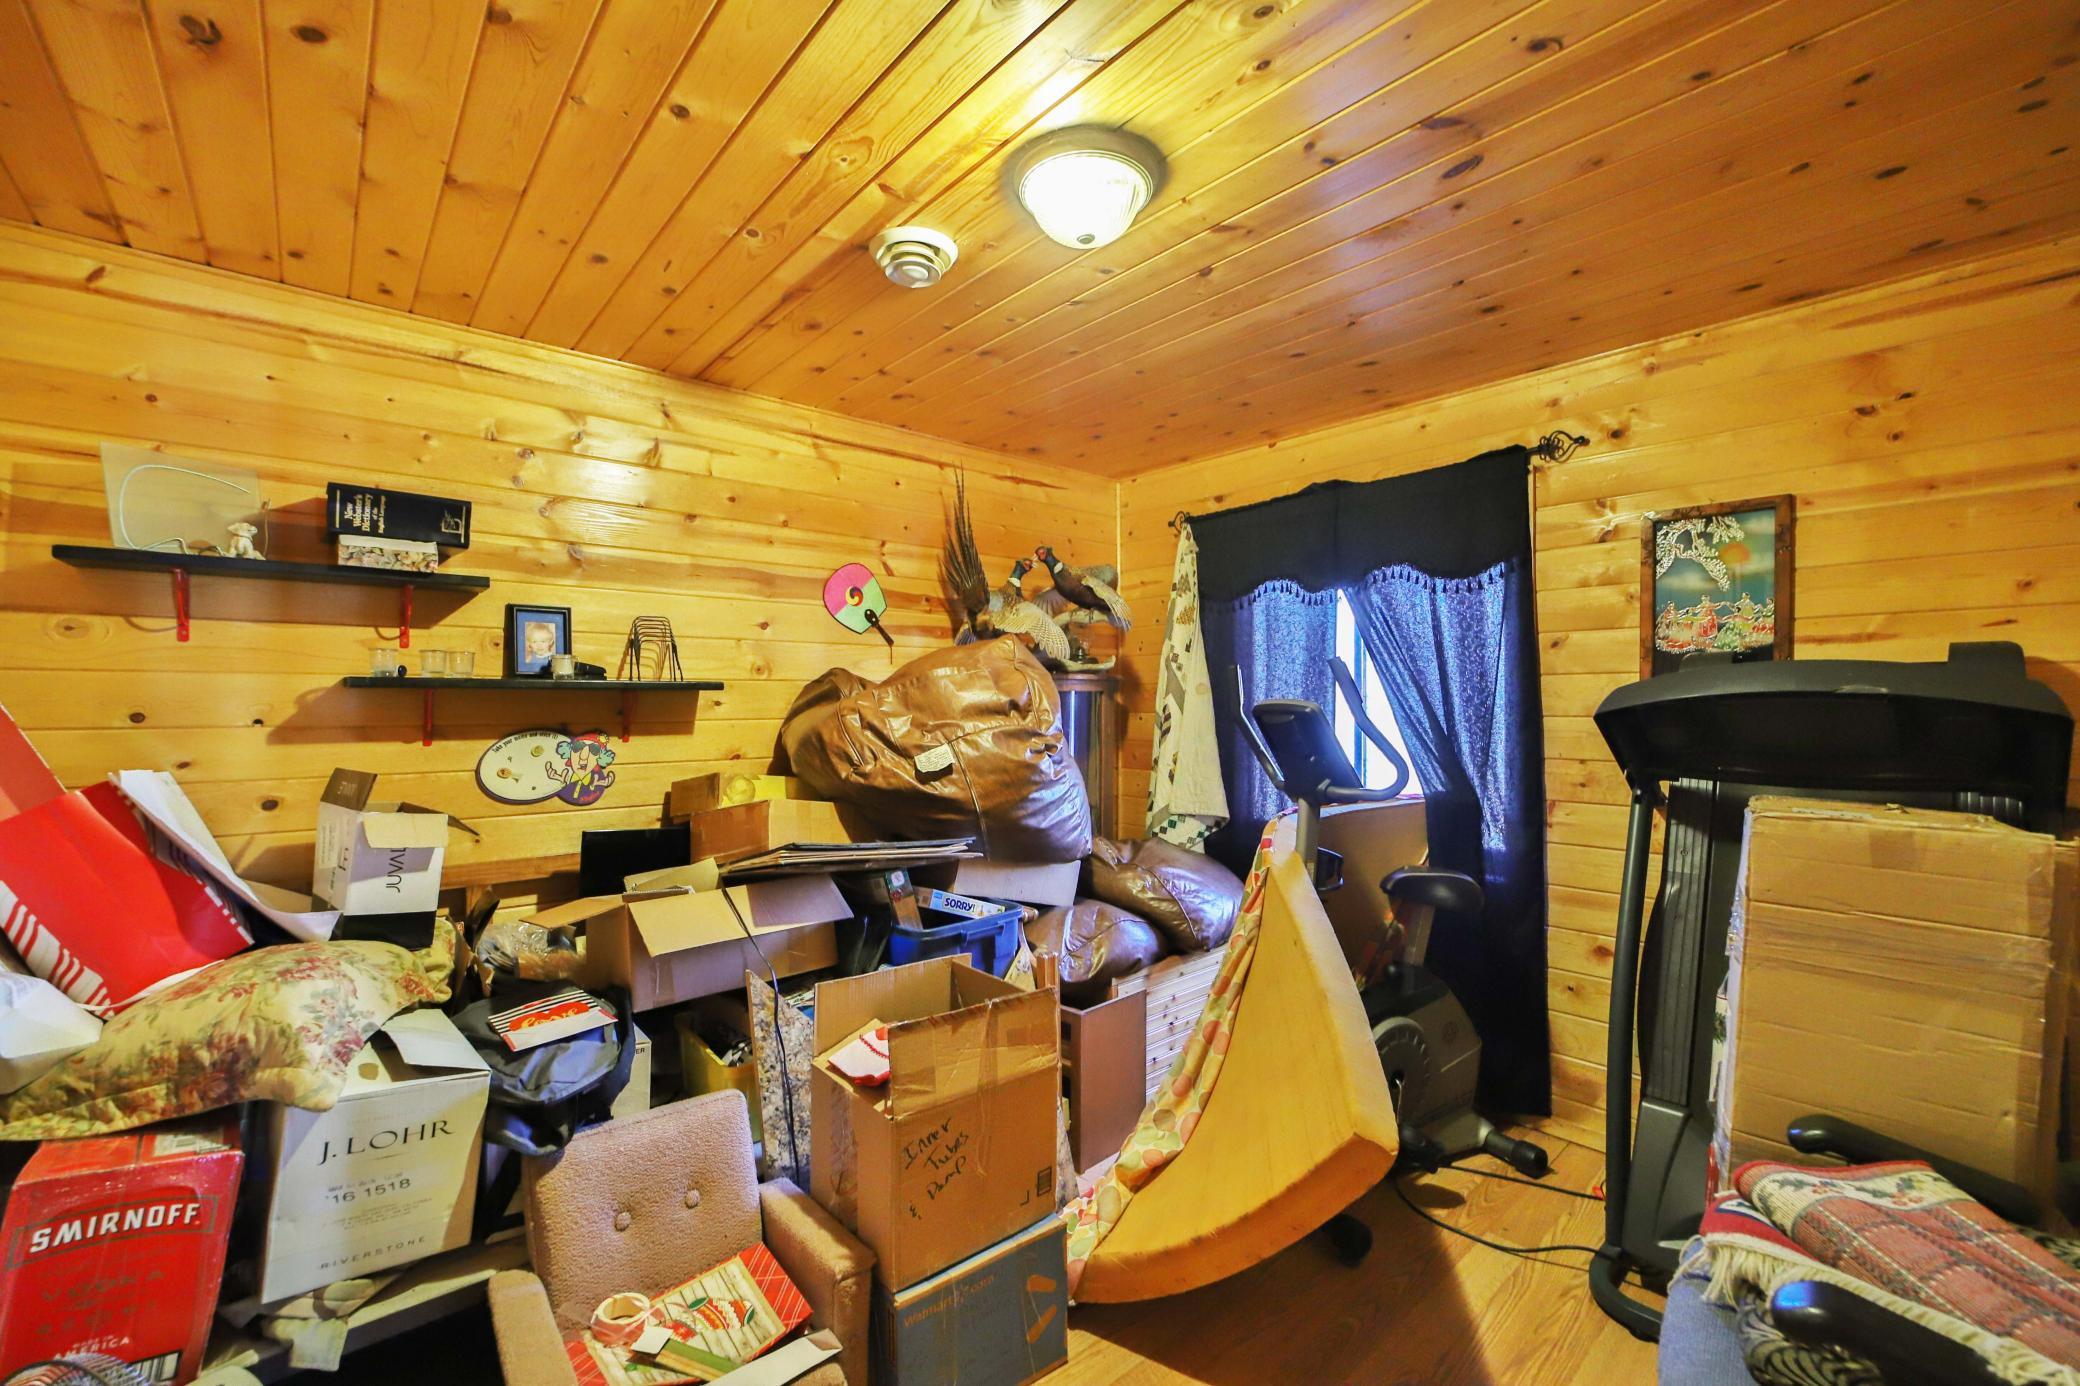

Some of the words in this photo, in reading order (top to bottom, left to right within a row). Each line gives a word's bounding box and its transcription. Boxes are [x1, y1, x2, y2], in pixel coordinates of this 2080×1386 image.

[344, 503, 354, 519] New
[353, 494, 362, 526] Webster's
[362, 494, 373, 531] Dictionary
[944, 897, 976, 913] SORRY!
[346, 1119, 454, 1155] LOHR
[903, 1118, 952, 1170] Inner
[922, 1131, 969, 1170] Tubes
[364, 1178, 411, 1198] 1518
[29, 1203, 201, 1254] SMIRNOFF
[319, 1235, 426, 1271] RIVERSTONE
